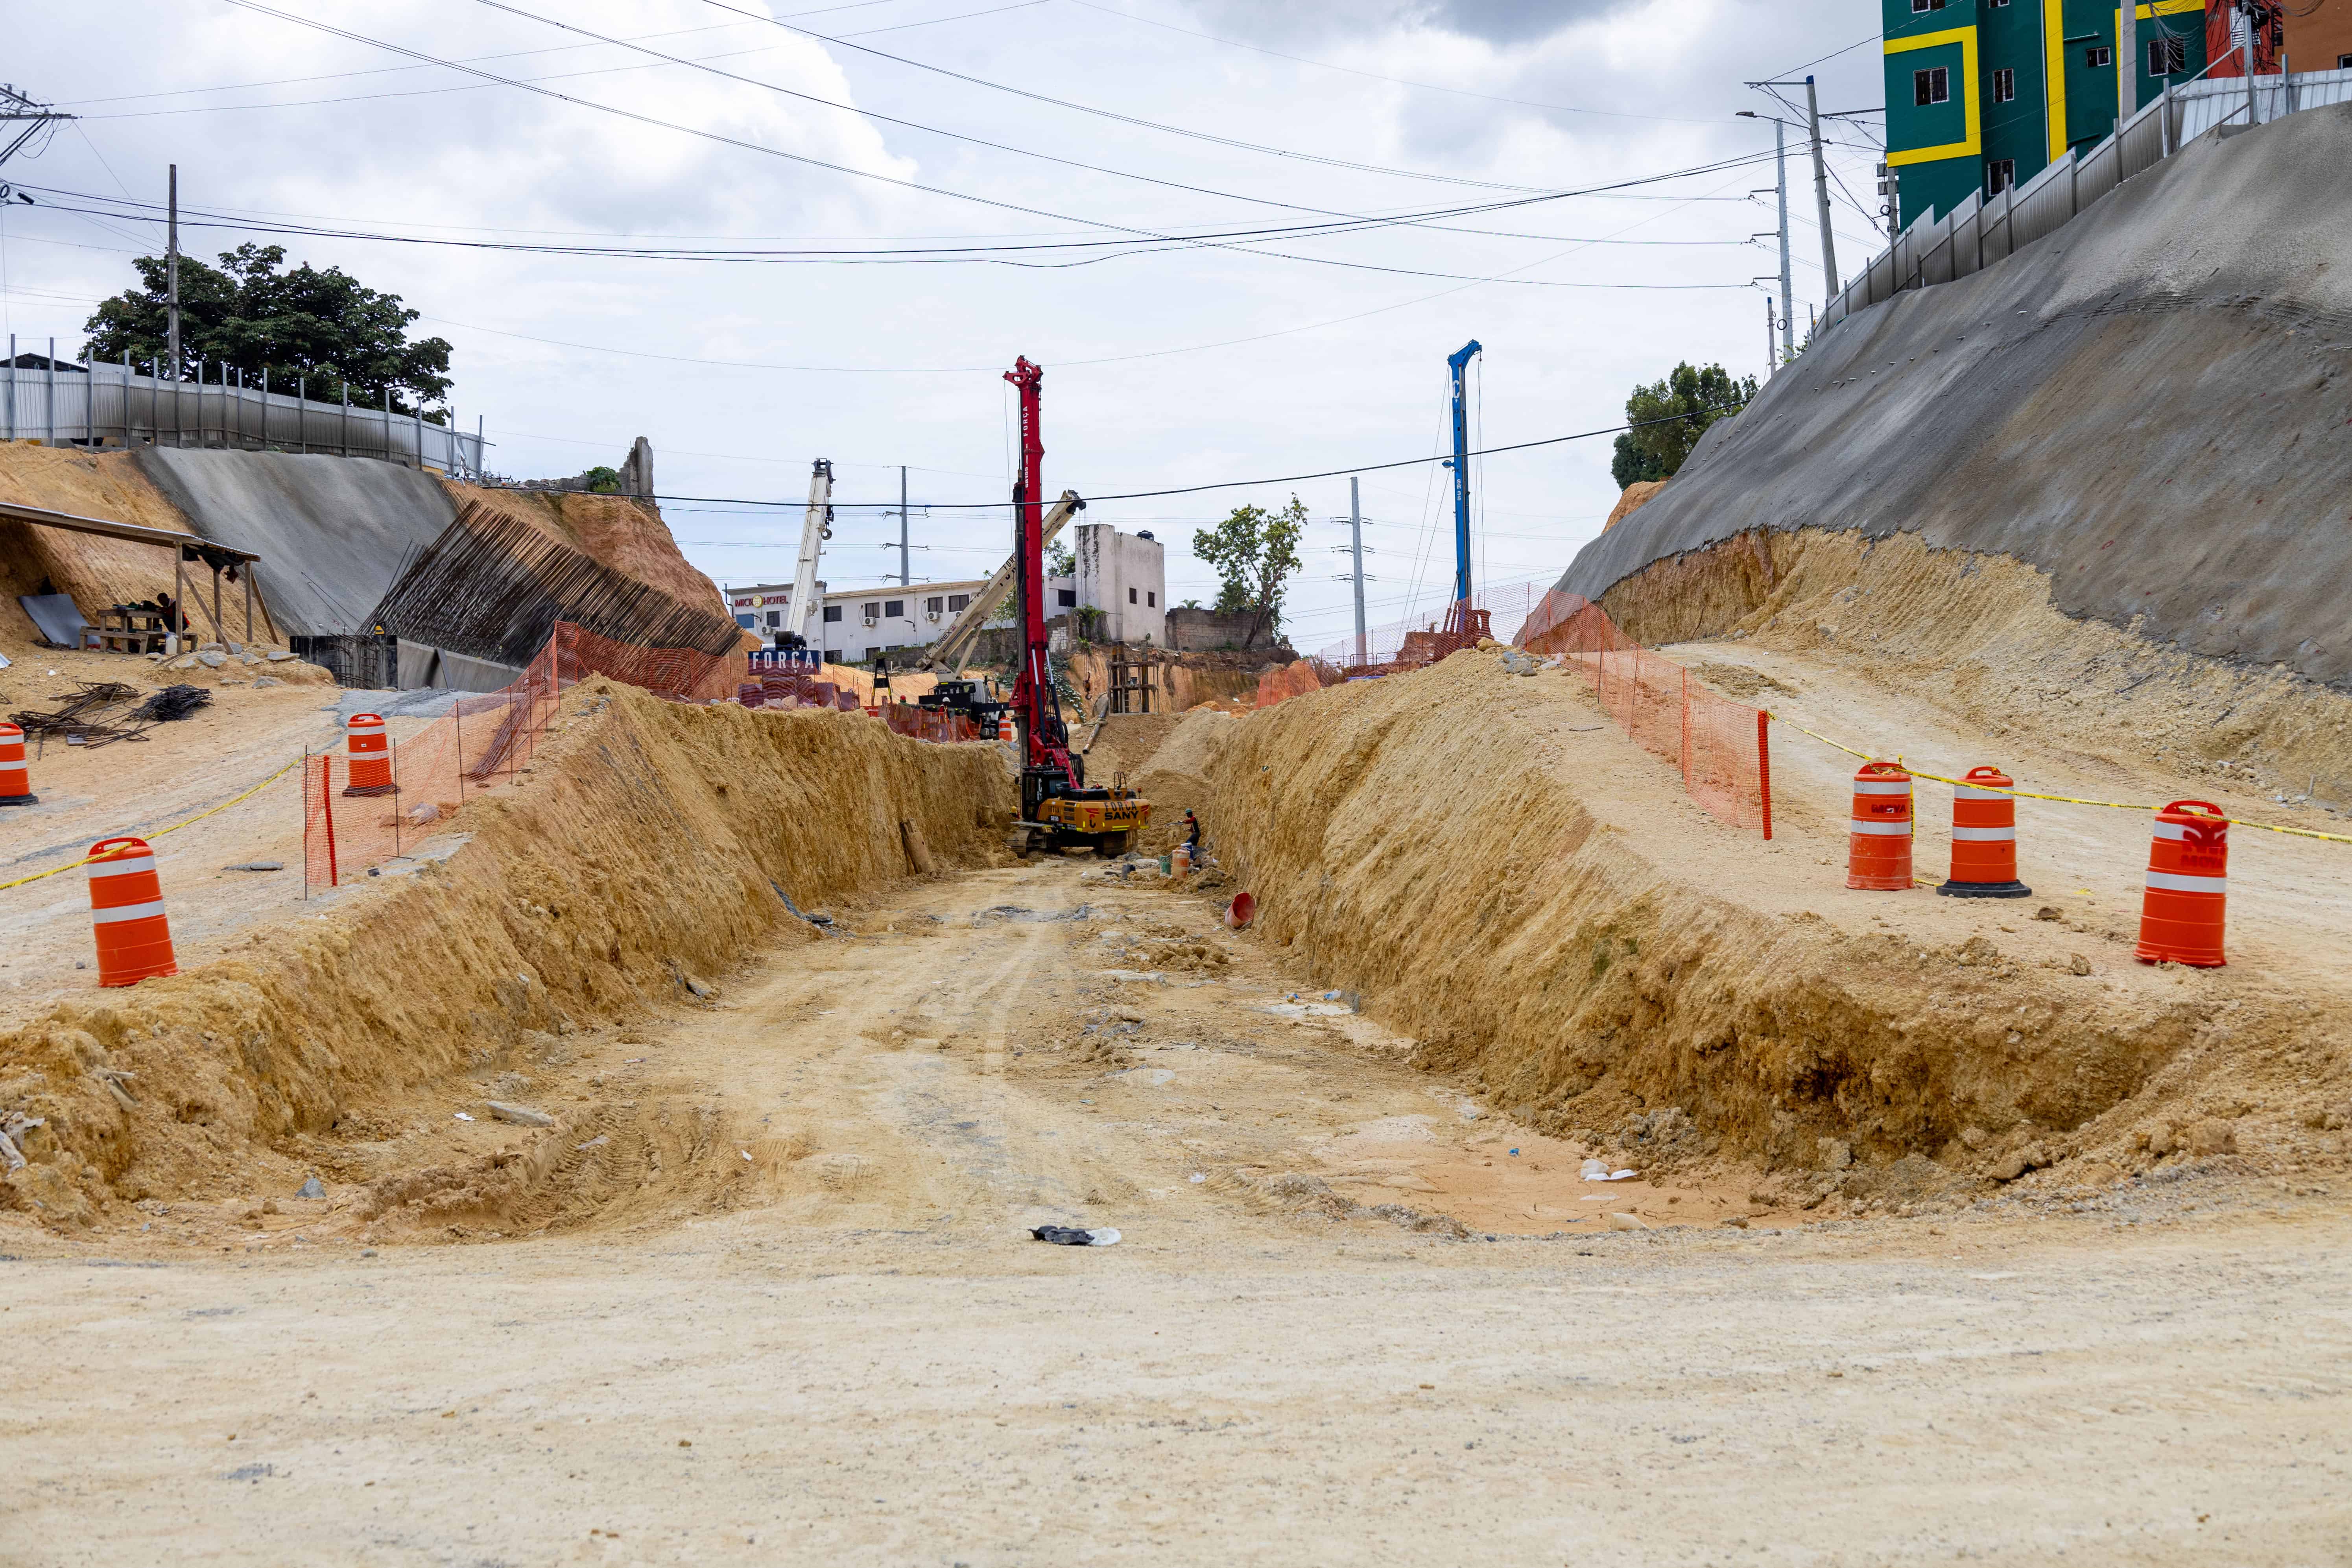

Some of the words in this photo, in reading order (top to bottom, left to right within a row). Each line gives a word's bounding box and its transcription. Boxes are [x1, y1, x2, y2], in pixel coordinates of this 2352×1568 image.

[762, 596, 787, 605] HOTEL
[933, 629, 952, 649] TEREX
[753, 651, 814, 674] FORÇA
[1105, 811, 1138, 820] SANY
